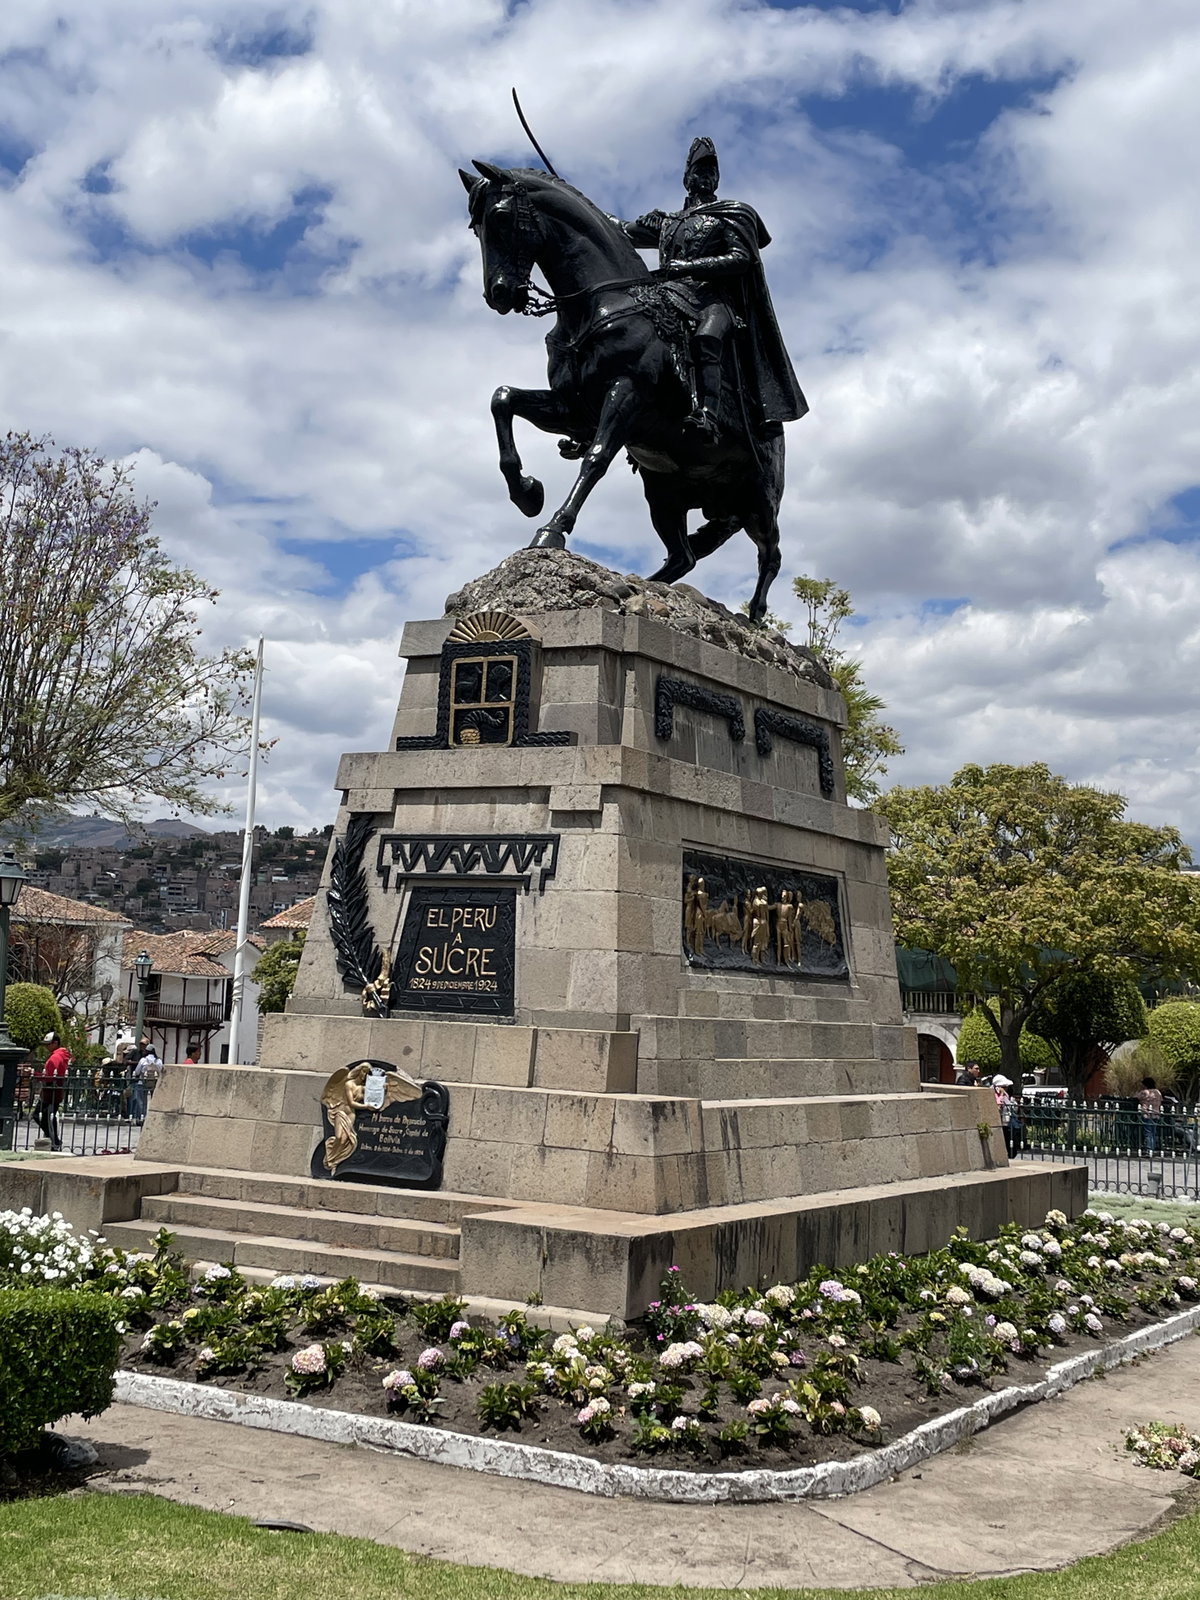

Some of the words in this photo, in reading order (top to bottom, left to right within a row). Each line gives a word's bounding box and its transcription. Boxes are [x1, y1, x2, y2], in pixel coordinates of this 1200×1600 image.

[427, 908, 449, 927] EL
[450, 905, 497, 933] PERU
[452, 932, 463, 946] A
[415, 942, 497, 978] SUCRE
[409, 977, 431, 990] 1824
[474, 979, 498, 992] 1924
